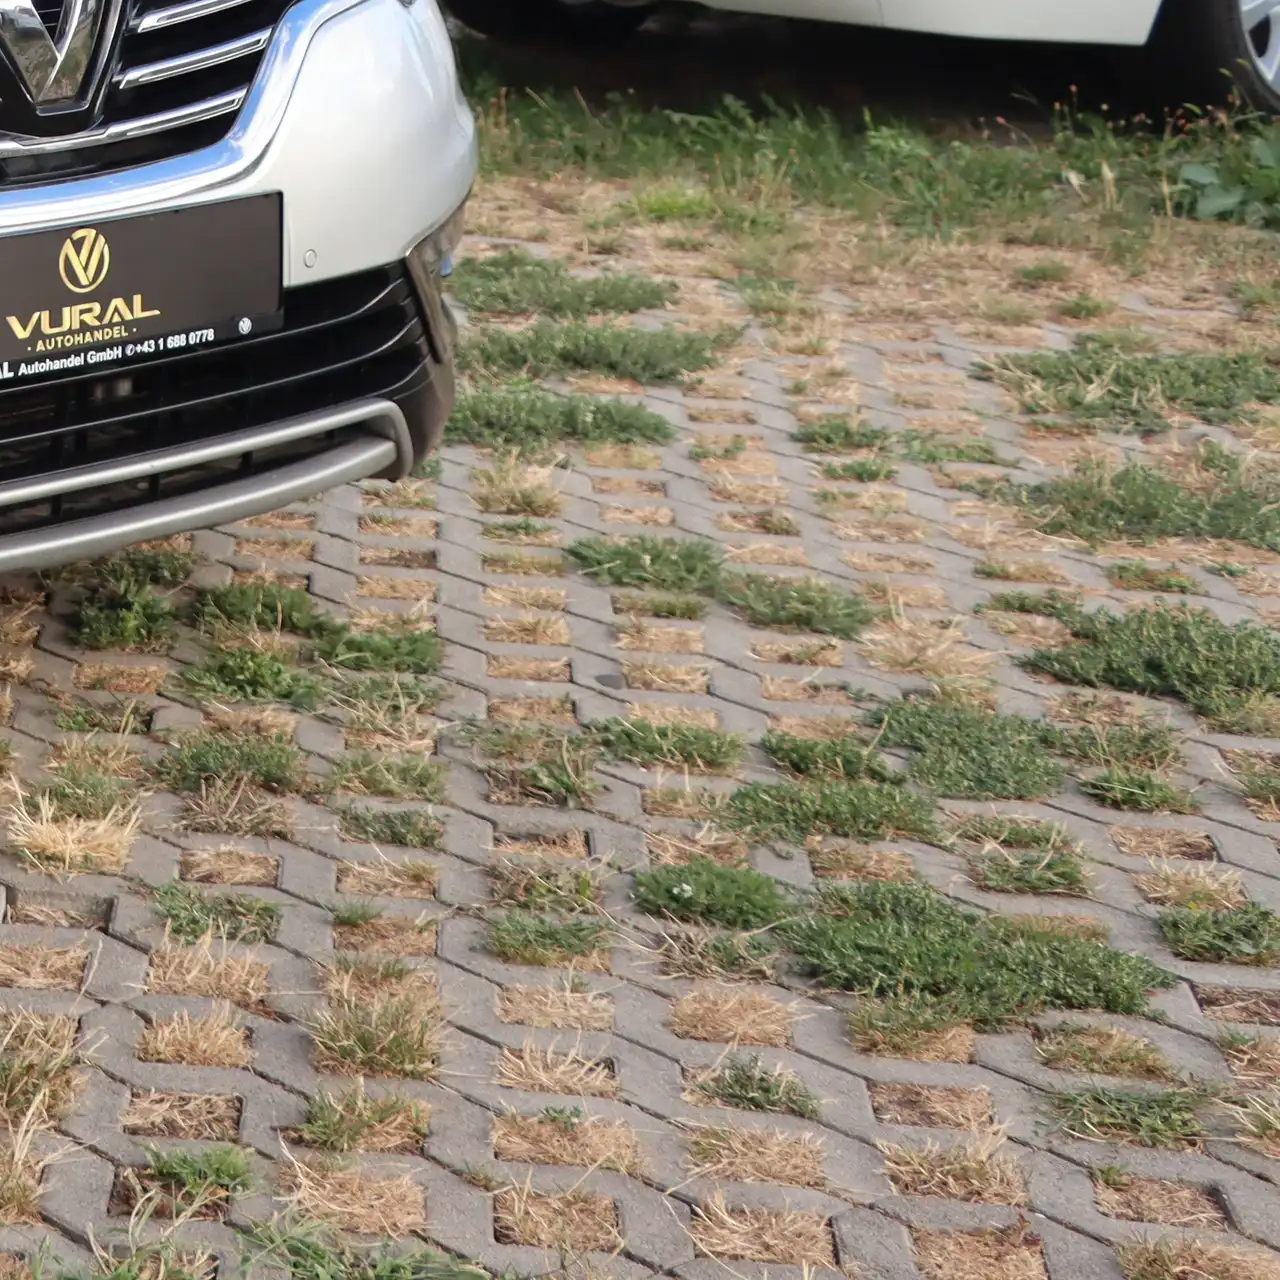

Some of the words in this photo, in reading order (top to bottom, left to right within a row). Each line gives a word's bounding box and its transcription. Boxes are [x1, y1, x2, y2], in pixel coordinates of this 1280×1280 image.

[6, 294, 161, 340] VURAL
[36, 325, 129, 352] AUTOHANDEL
[17, 352, 85, 377] Autohandel
[87, 345, 123, 364] GmbH
[157, 338, 164, 351] 1
[166, 334, 187, 350] 688
[189, 328, 215, 345] 0778
